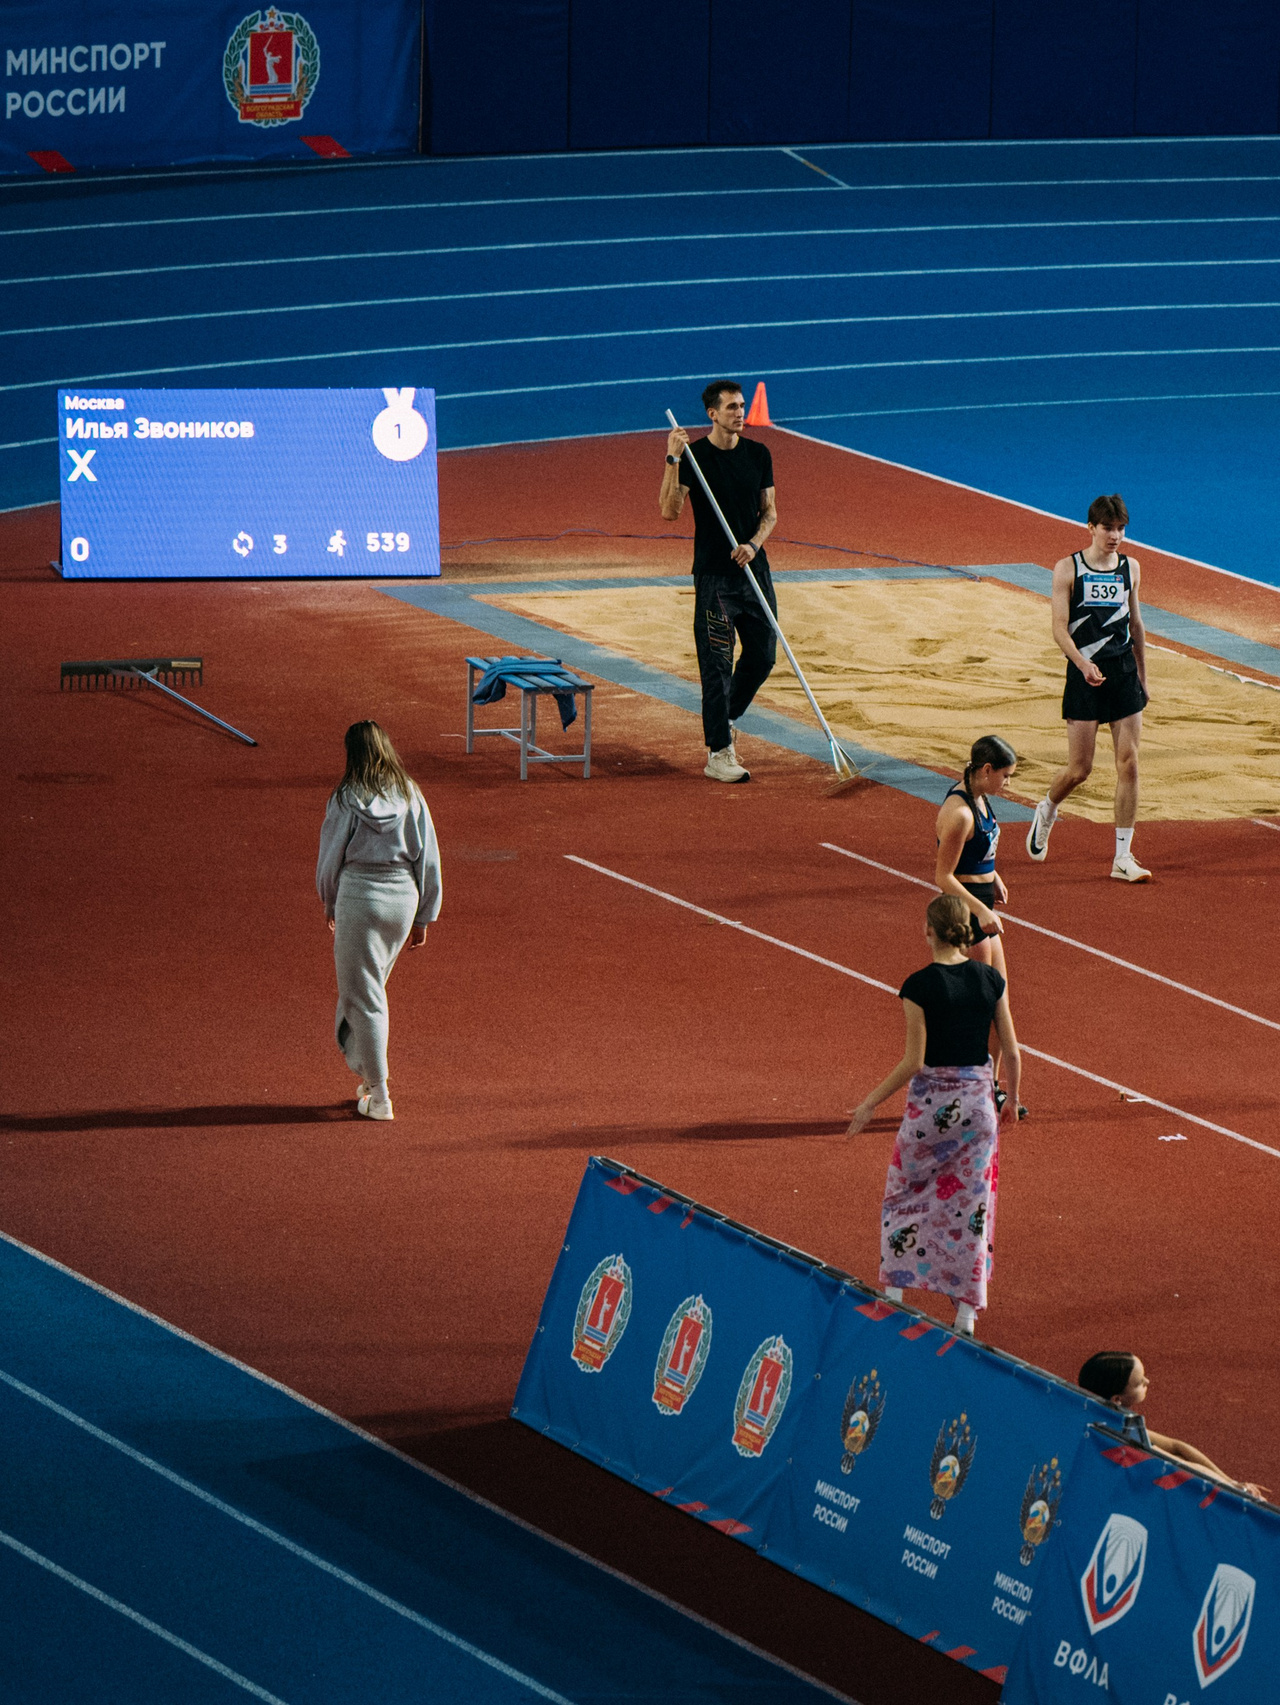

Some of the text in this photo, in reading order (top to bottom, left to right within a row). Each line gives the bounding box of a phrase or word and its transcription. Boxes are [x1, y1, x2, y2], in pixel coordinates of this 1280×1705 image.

[6, 42, 166, 77] МИНСПОРТ
[6, 87, 126, 119] РОССИИ
[64, 396, 125, 411] Москва
[65, 417, 255, 439] Илья Звоников
[394, 423, 402, 440] 1
[70, 537, 89, 562] 0
[272, 532, 411, 554] 3 539
[1091, 585, 1118, 599] 539
[814, 1479, 861, 1514] МИНСПОРТ
[812, 1504, 849, 1533] РОССИИ
[903, 1524, 952, 1560] МИНСПОРТ
[901, 1549, 939, 1580] РОССИИ
[1053, 1639, 1109, 1691] ВФЛА
